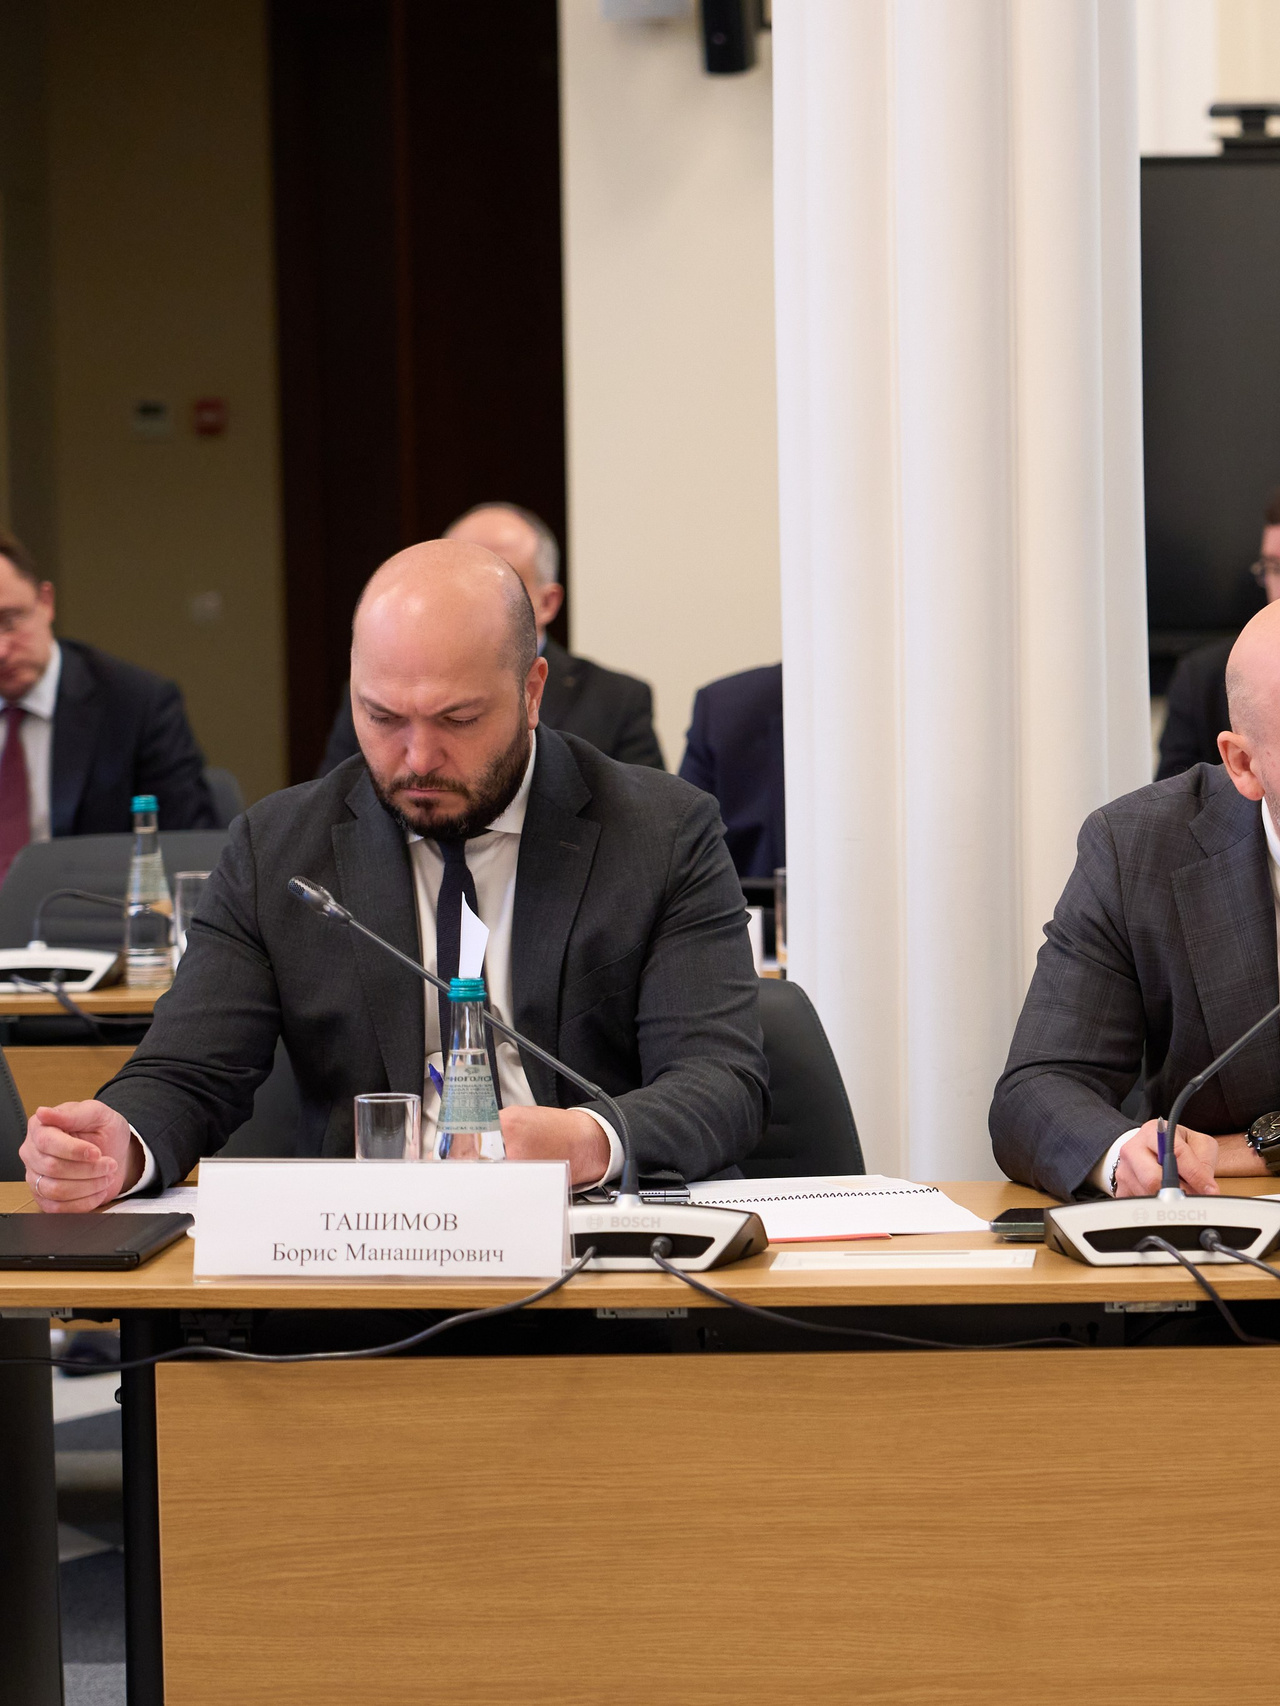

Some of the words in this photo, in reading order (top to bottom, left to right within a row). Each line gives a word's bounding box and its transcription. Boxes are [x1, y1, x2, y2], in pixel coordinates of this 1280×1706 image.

[320, 1212, 459, 1232] ТАШИМОВ
[610, 1216, 662, 1228] BOSCH
[1156, 1209, 1207, 1222] BOSCH
[272, 1242, 338, 1266] Борис
[345, 1242, 505, 1266] Манаширович
